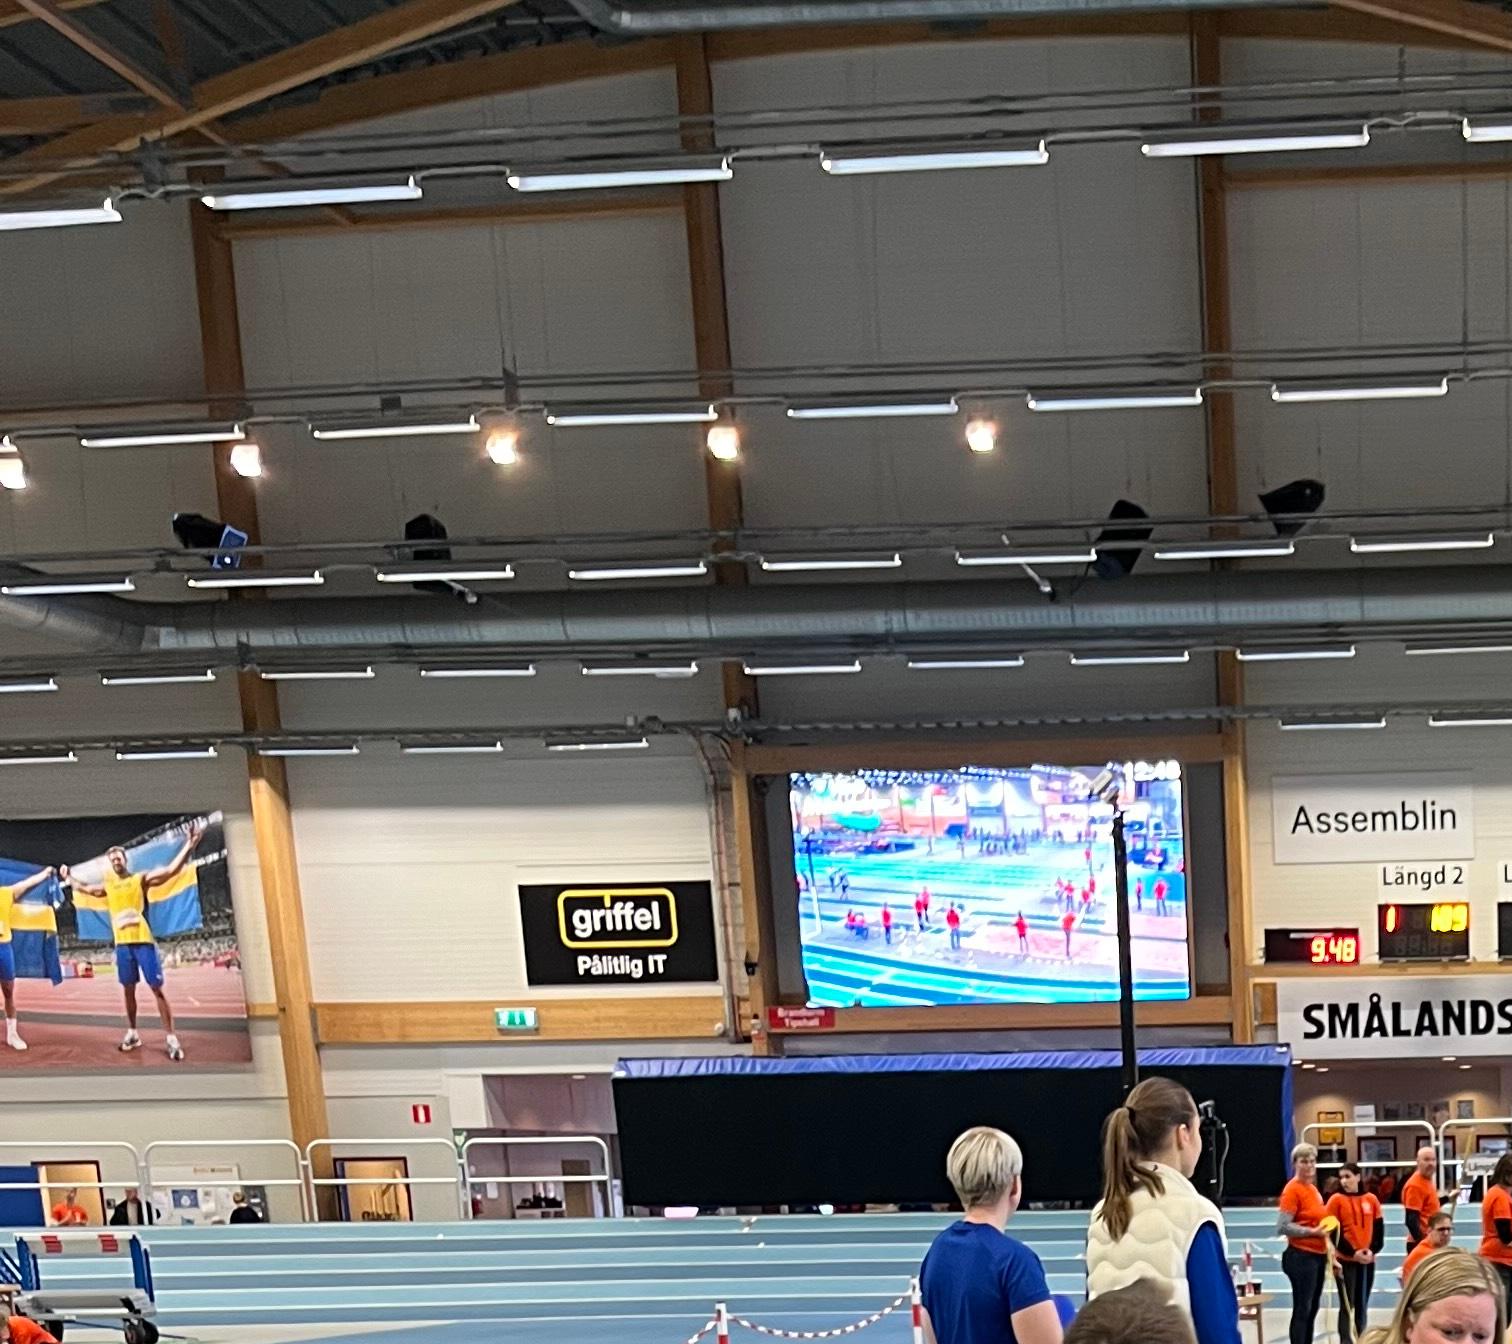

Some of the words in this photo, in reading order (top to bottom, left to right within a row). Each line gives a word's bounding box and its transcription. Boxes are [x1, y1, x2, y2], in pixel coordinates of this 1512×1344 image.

[1291, 799, 1457, 835] Assemblin
[1382, 864, 1446, 891] Längd
[1452, 866, 1464, 885] 2
[571, 895, 662, 938] griffel
[1310, 935, 1357, 964] 9.48
[576, 953, 644, 979] Pålitlig
[647, 954, 668, 974] IT
